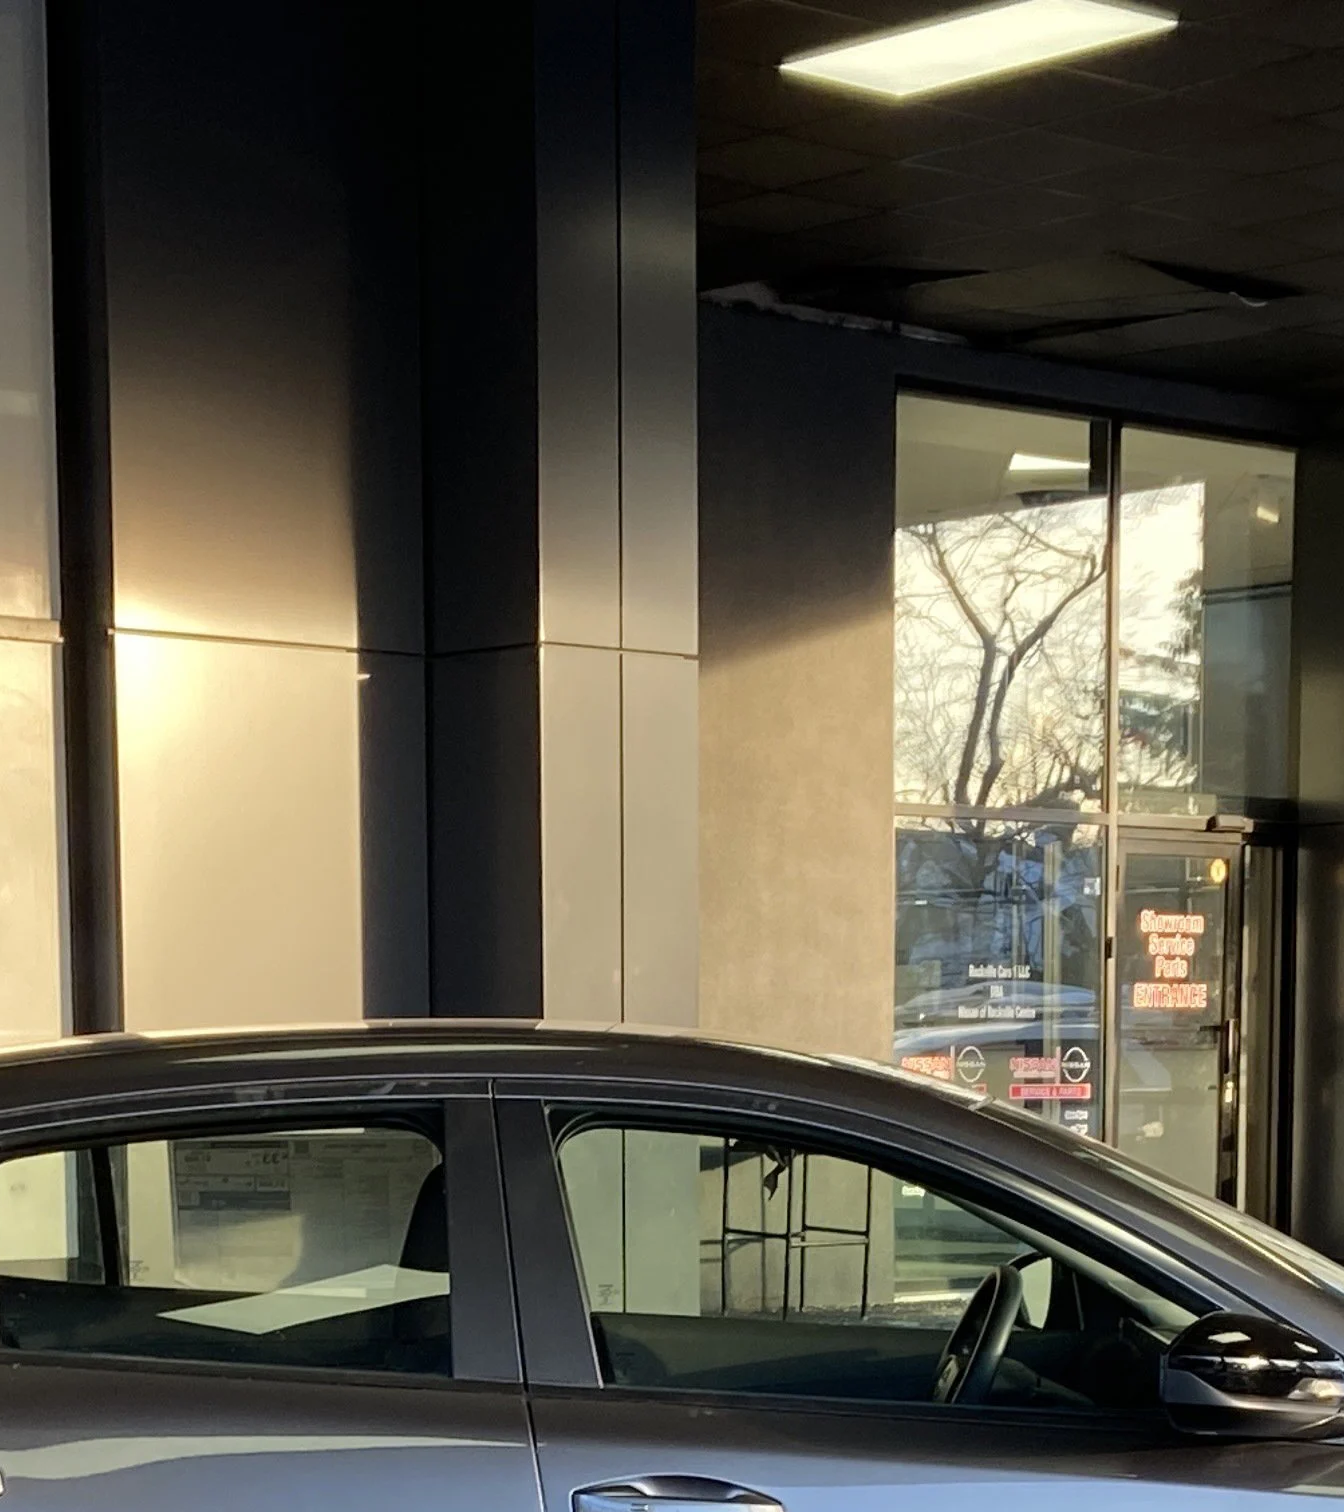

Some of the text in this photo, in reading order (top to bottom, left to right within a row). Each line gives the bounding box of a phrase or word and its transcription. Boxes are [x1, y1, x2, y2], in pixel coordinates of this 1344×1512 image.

[1140, 909, 1204, 934] Showroom
[1148, 933, 1195, 955] Service
[1154, 956, 1188, 978] Parts
[1133, 982, 1207, 1008] ENTRANCE
